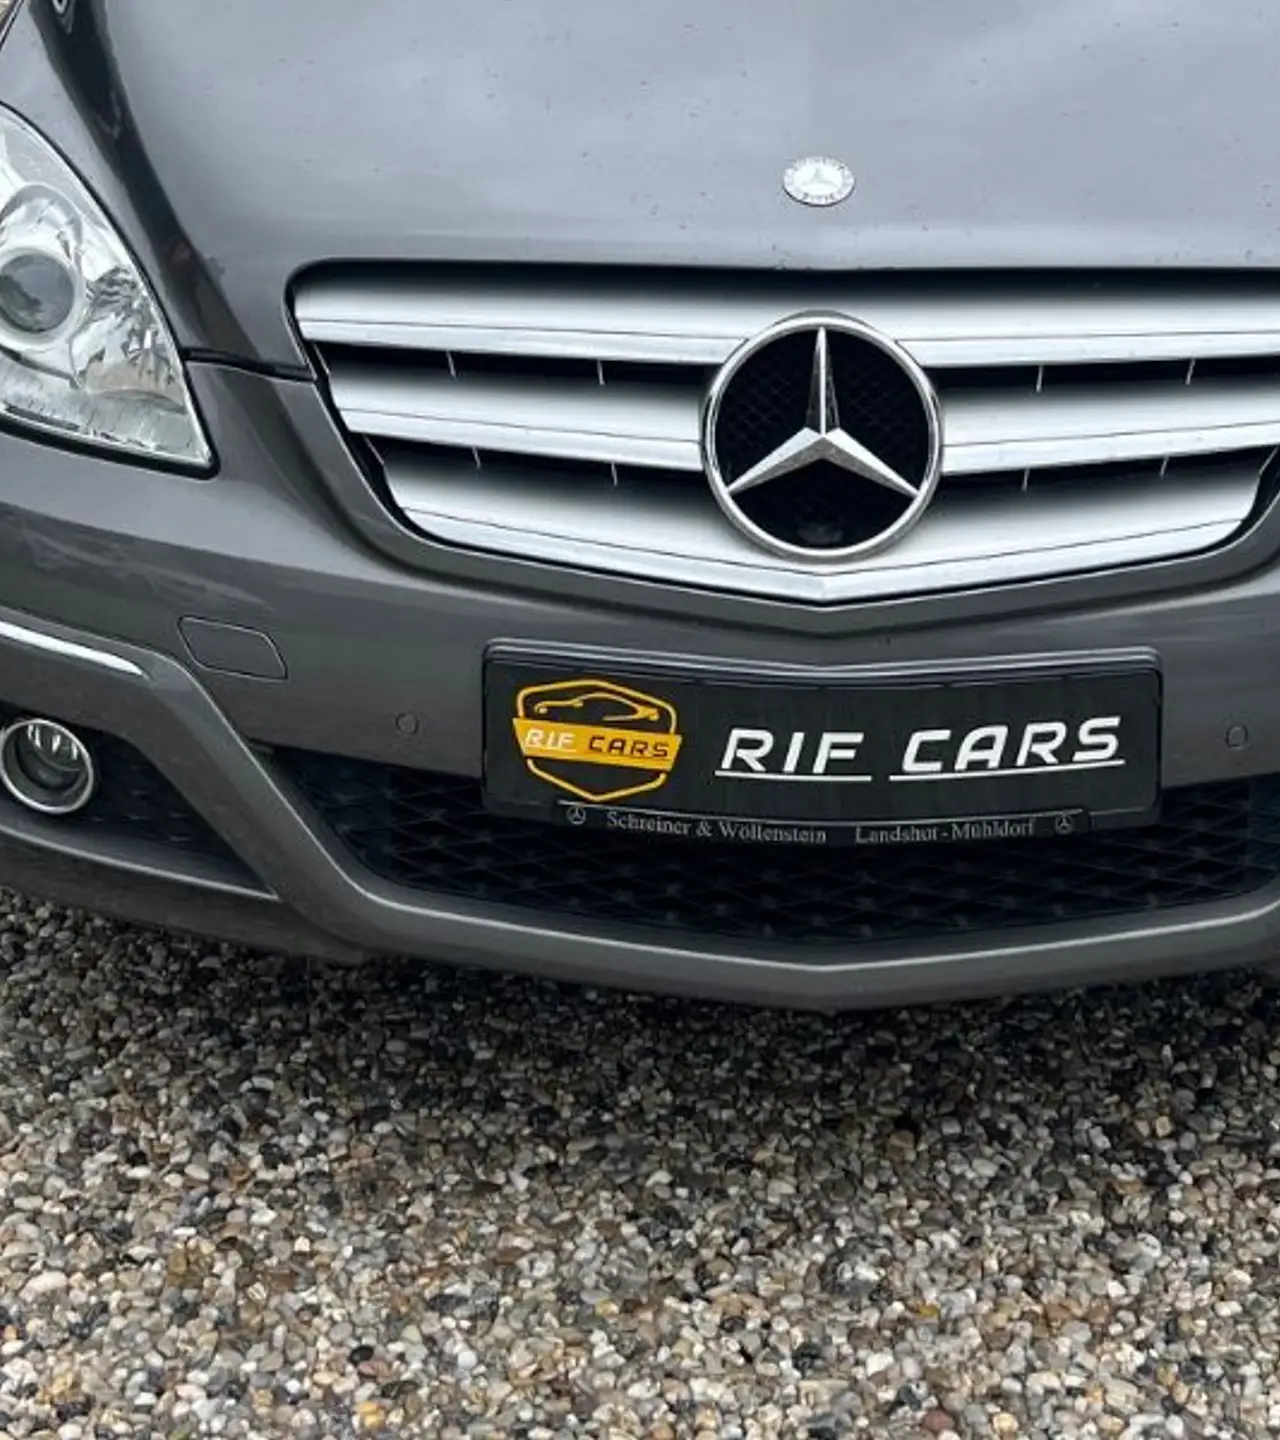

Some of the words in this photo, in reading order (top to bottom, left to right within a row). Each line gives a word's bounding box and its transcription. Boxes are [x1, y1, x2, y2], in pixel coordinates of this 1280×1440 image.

[525, 728, 576, 751] RIF
[588, 734, 669, 758] CARS
[722, 729, 864, 774] RIF
[902, 717, 1120, 773] CARS
[606, 810, 689, 836] Schreiner
[696, 820, 713, 838] &
